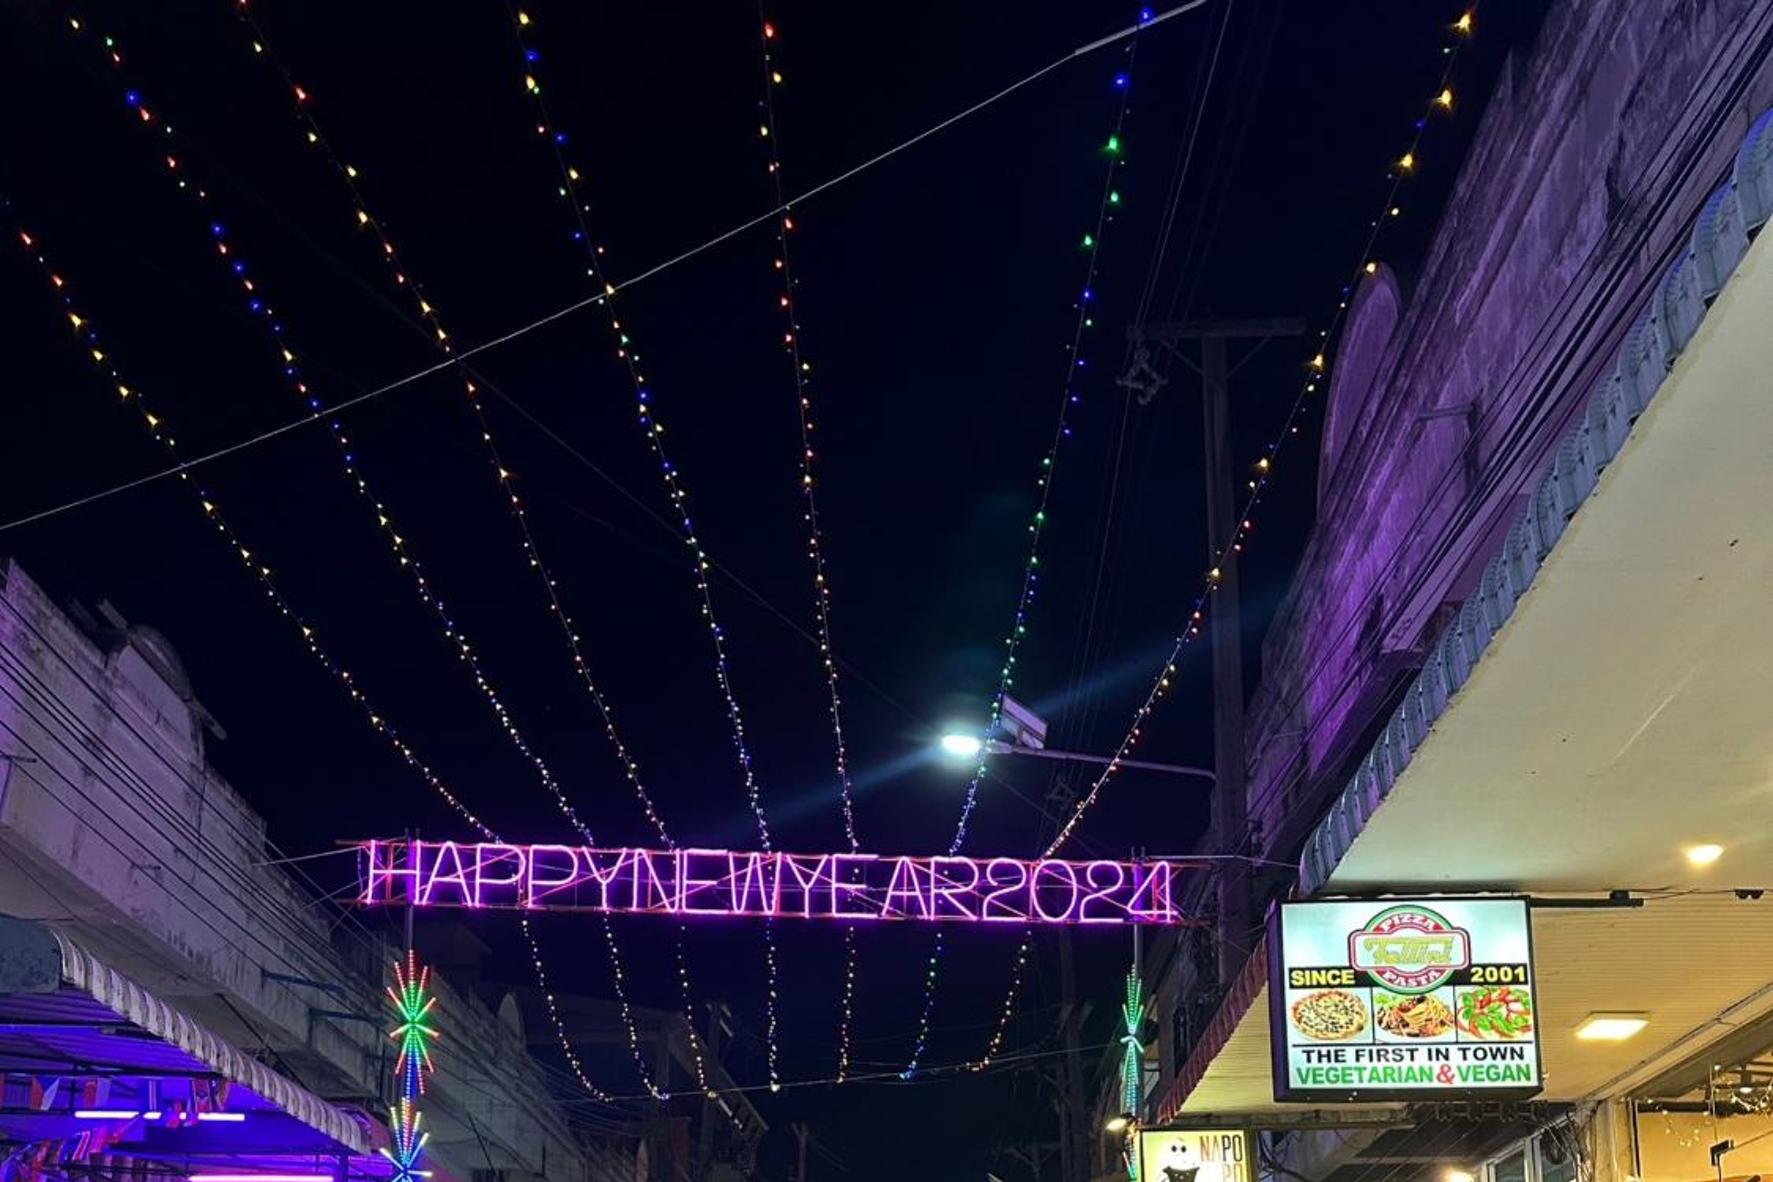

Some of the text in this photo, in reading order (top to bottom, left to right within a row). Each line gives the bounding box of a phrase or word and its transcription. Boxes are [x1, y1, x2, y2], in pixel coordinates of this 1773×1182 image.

[364, 839, 1179, 923] HAPPY NEW YEAR 2024
[1381, 912, 1438, 933] PIZZA
[1291, 967, 1526, 986] SINCE 2001
[1382, 969, 1440, 987] PASTA
[1302, 1046, 1525, 1063] THE FIRST IN TOWN
[1296, 1063, 1531, 1085] VEGETARIAN & VEGAN
[1199, 1134, 1243, 1162] NAPO
